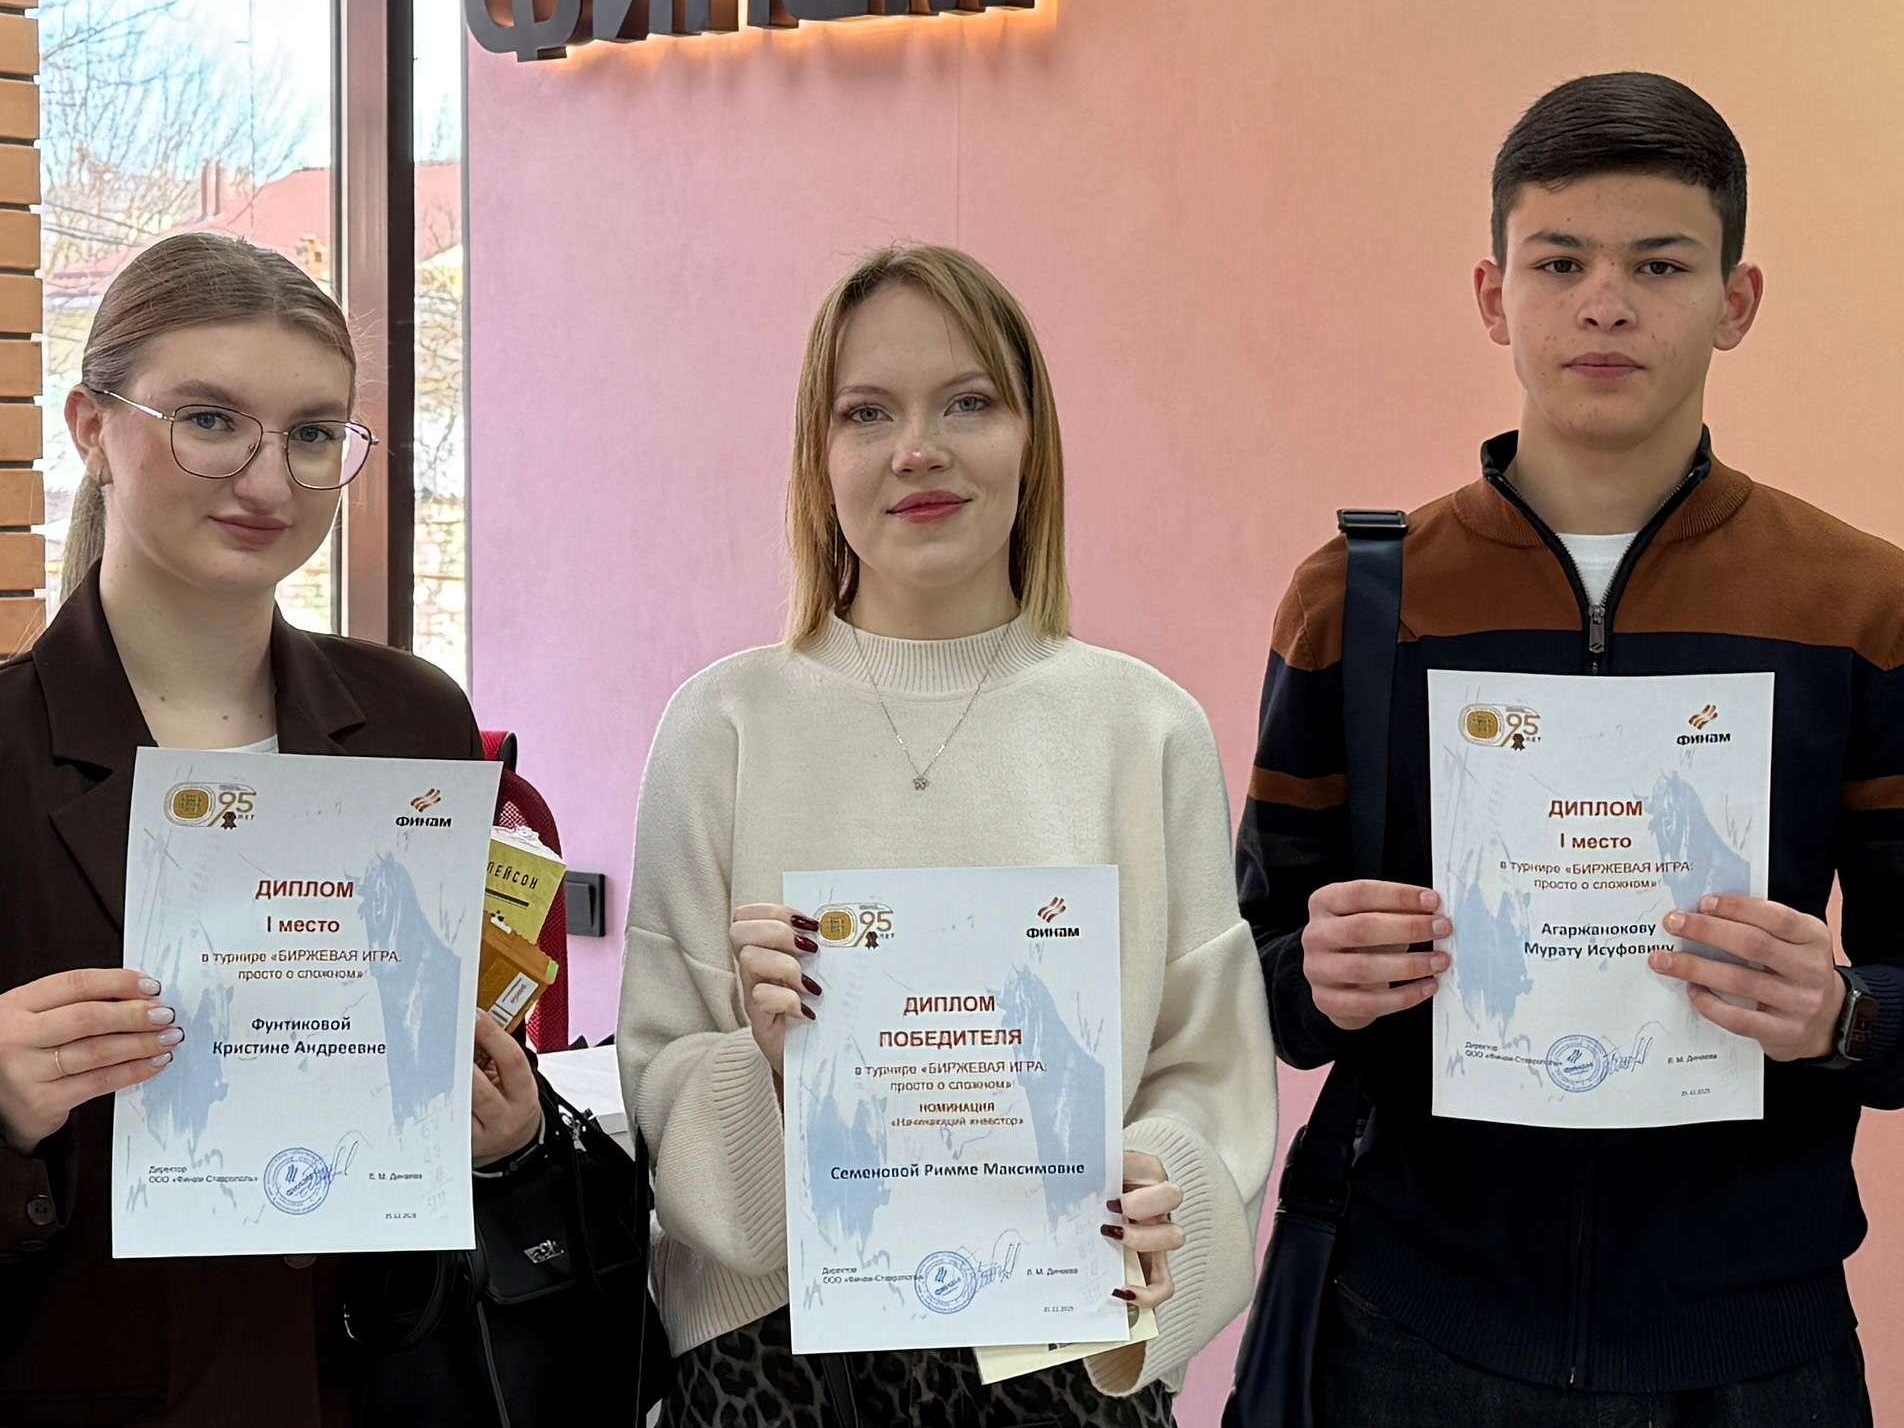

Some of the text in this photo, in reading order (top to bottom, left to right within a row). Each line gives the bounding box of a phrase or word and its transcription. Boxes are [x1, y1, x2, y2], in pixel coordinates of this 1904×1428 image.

[1548, 800, 1643, 818] ДИПЛОМ
[1560, 833, 1632, 849] I место
[1500, 861, 1507, 869] в
[1511, 861, 1561, 874] турнире
[1565, 862, 1651, 875] «БИРЖЕВАЯ
[255, 880, 355, 900] ДИПЛОМ
[1534, 879, 1577, 890] просто
[1581, 881, 1589, 889] о
[267, 915, 340, 933] I место
[1542, 923, 1656, 938] Агаржанокову
[214, 952, 266, 965] турнире
[270, 949, 358, 963] «БИРЖЕВАЯ
[1524, 942, 1583, 958] Мурату
[238, 970, 283, 982] просто
[286, 971, 294, 979] о
[903, 995, 995, 1016] ДИПЛОМ
[251, 1016, 351, 1035] Фунтиковой
[879, 1029, 1022, 1049] ПОБЕДИТЕЛЯ
[212, 1041, 386, 1057] Кристине Андреевне
[865, 1065, 917, 1078] турнире
[921, 1061, 1005, 1074] «БИРЖЕВАЯ
[890, 1082, 934, 1093] просто
[937, 1082, 945, 1090] о
[919, 1102, 995, 1114] НОМИНАЦИЯ
[830, 1163, 1085, 1181] Семеновой Римме Максимовне
